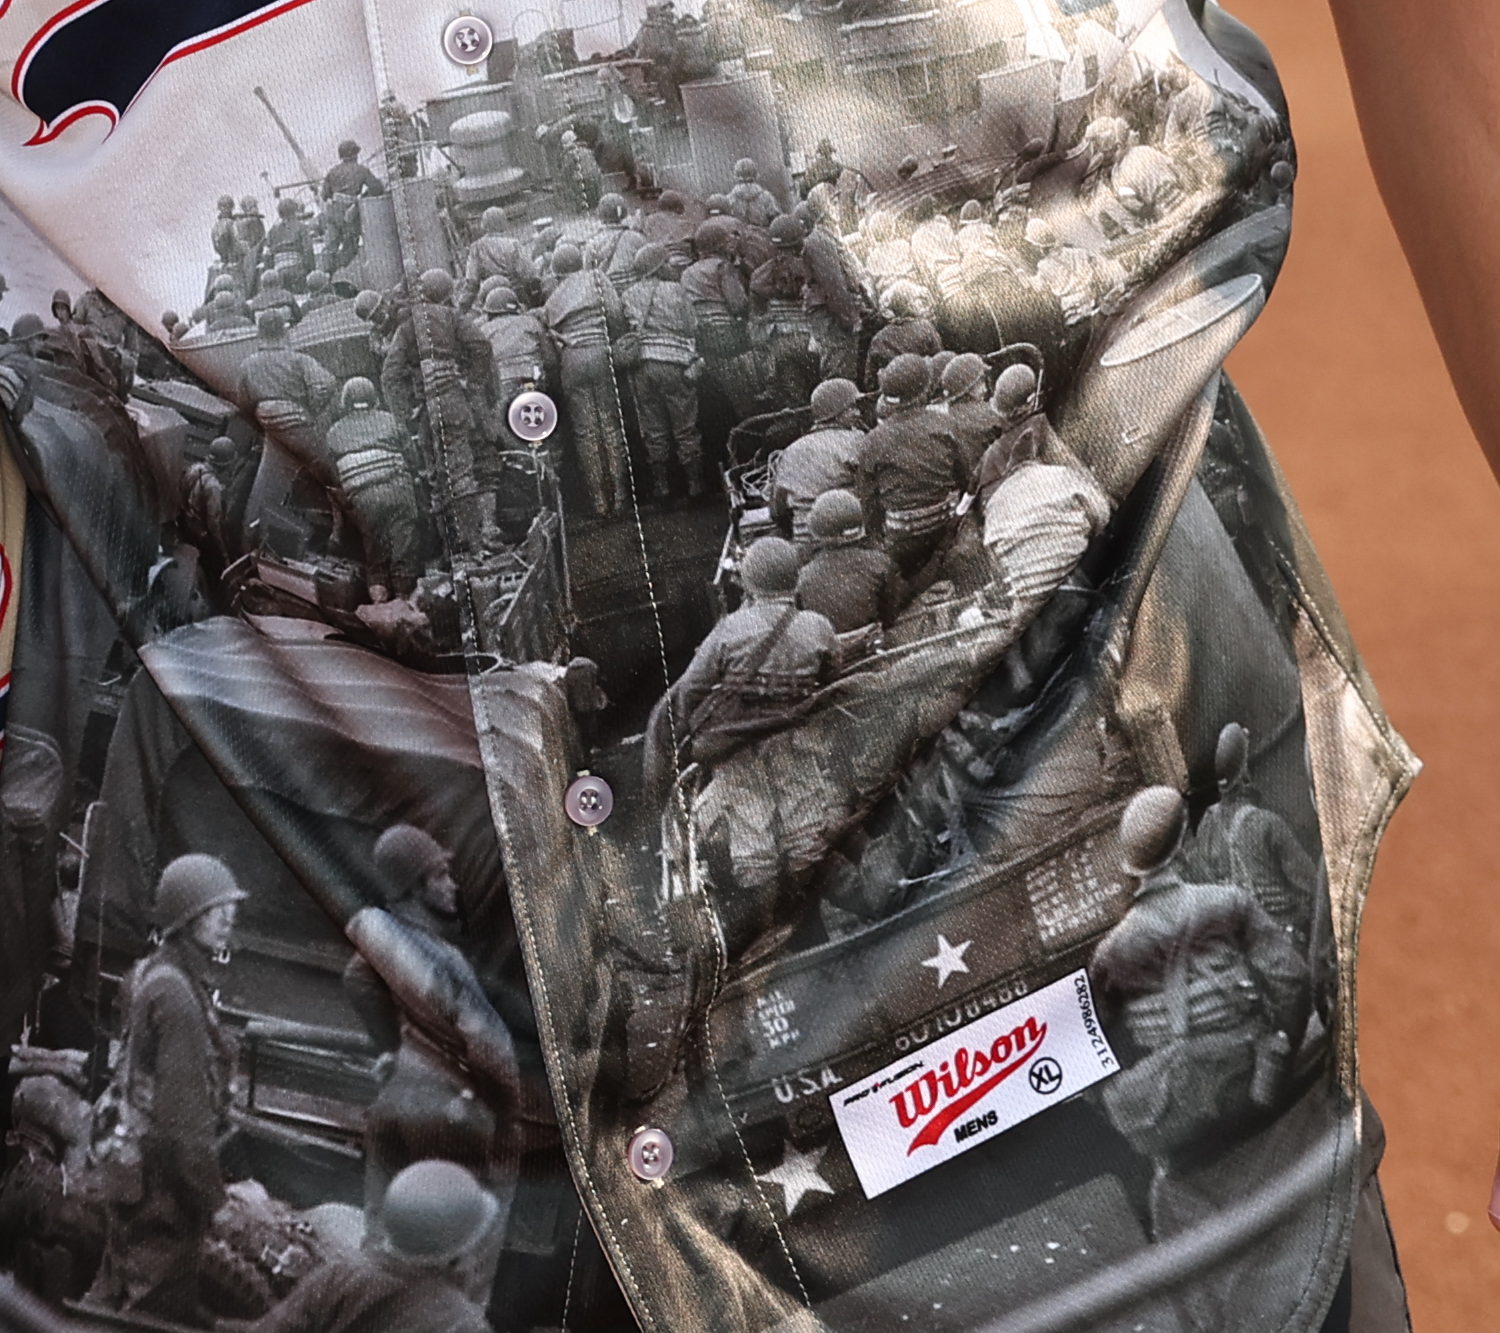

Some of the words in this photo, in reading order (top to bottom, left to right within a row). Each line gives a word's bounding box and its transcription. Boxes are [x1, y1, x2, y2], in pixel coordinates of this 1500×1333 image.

[1074, 975, 1115, 1068] 3124986282
[889, 1016, 1047, 1129] Wilson
[1030, 1063, 1061, 1091] XL
[953, 1110, 998, 1143] MENS
